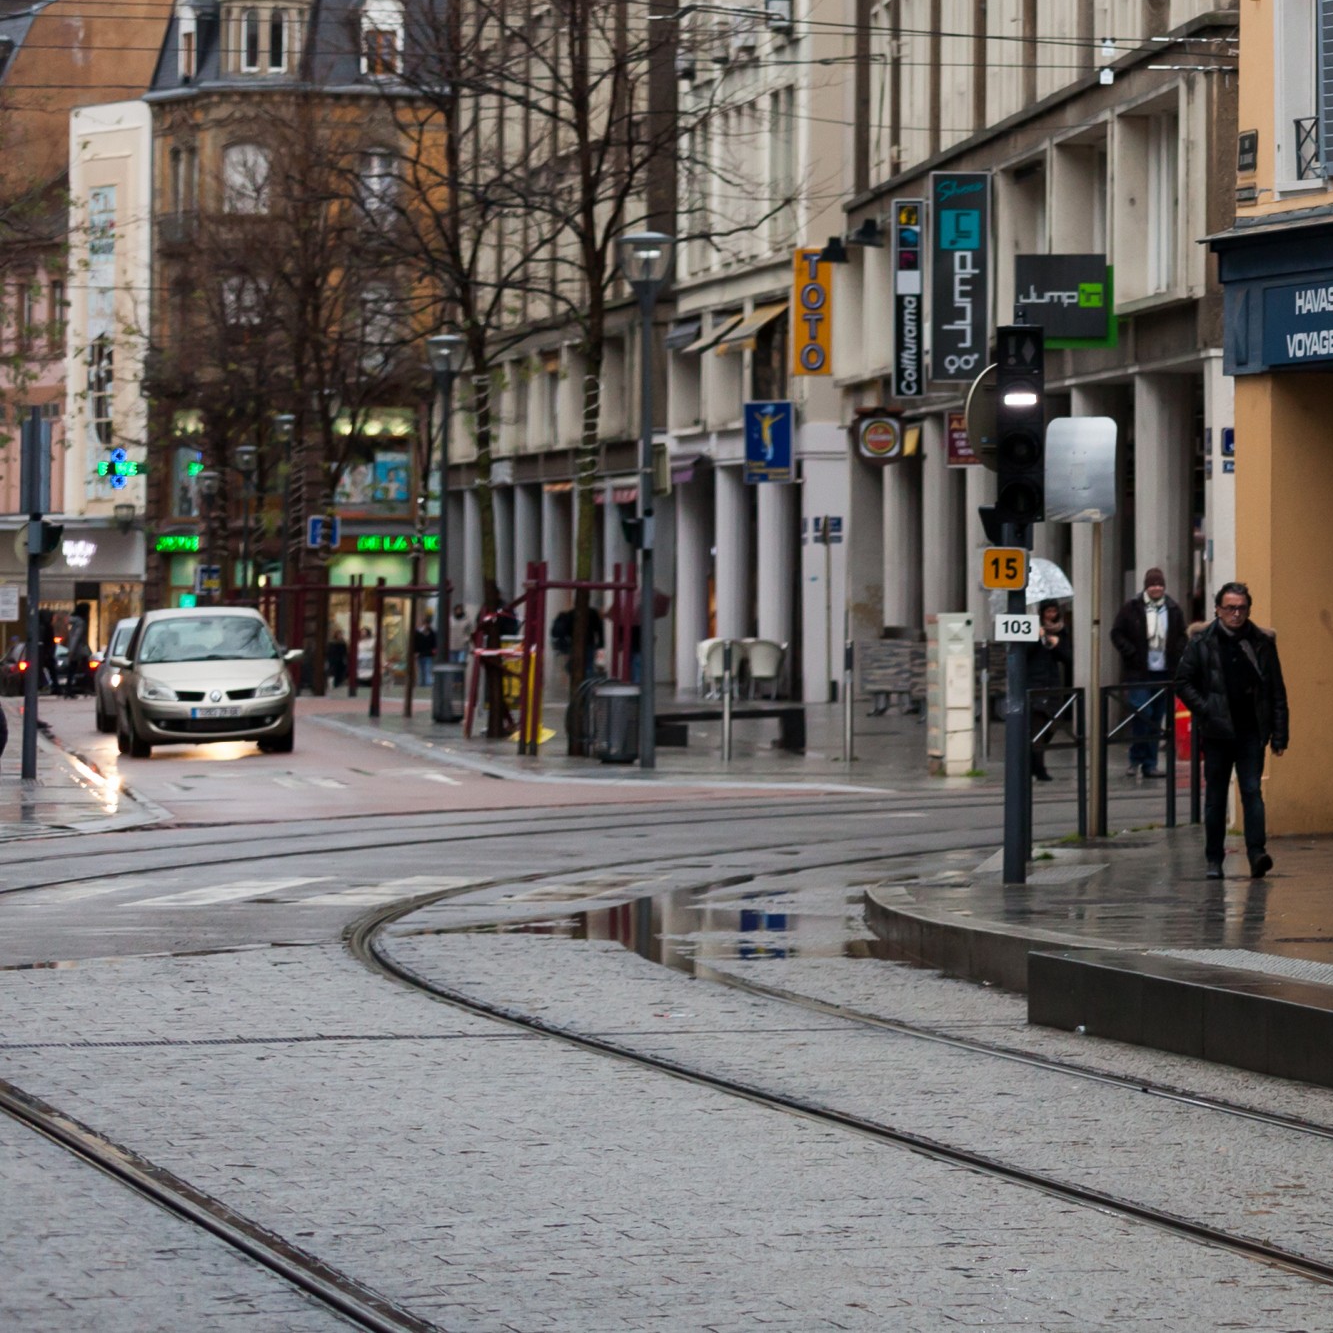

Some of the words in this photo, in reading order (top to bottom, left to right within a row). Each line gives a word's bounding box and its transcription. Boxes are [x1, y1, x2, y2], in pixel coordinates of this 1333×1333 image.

[801, 252, 826, 371] TOTO
[900, 295, 918, 395] Coiffurama
[991, 557, 1018, 580] 15
[1002, 620, 1032, 635] 103
